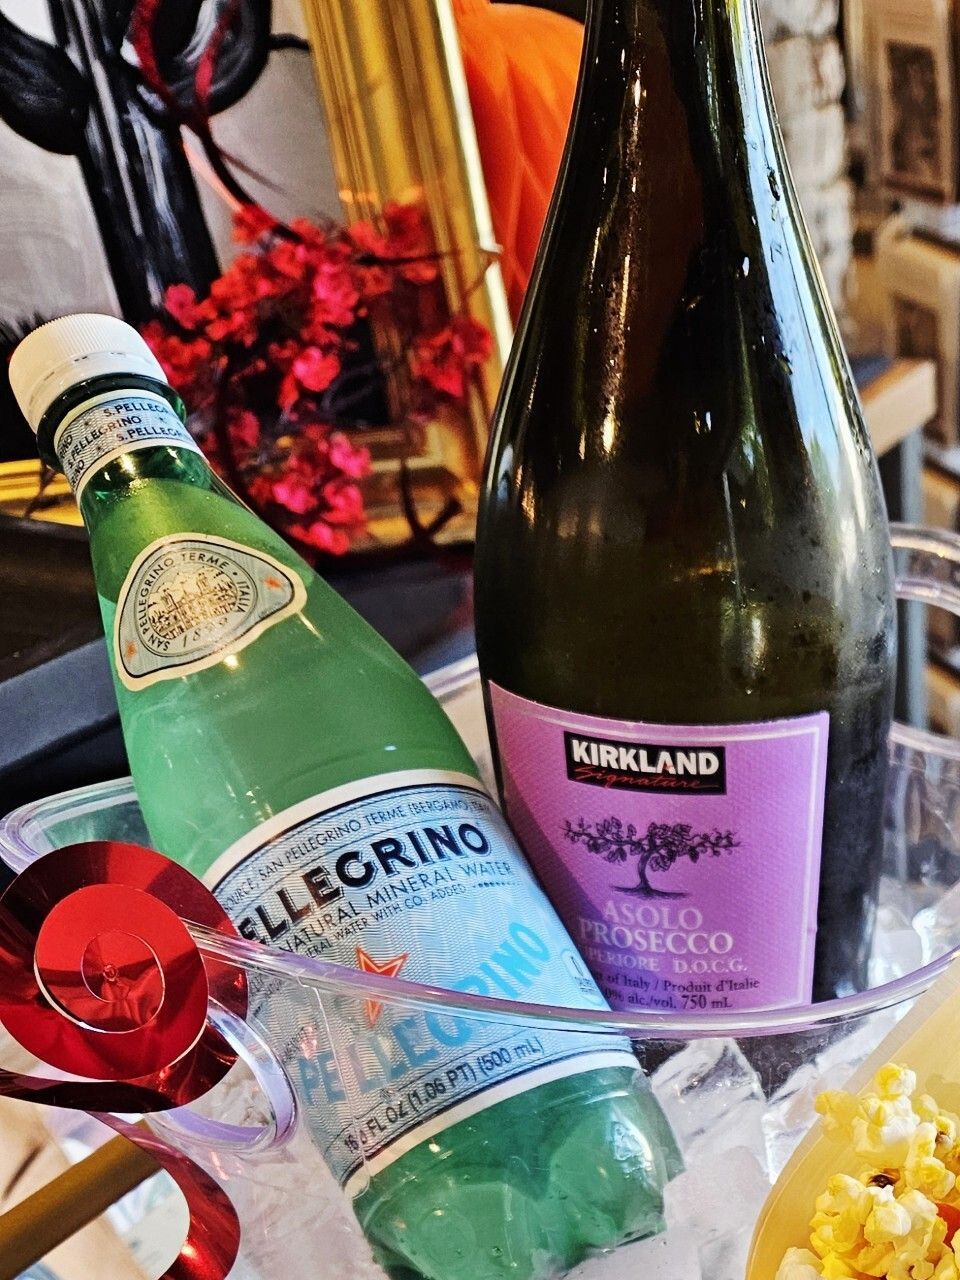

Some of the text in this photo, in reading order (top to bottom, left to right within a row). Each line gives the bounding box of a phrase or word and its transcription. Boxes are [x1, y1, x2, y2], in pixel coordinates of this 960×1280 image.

[181, 552, 230, 570] TERME
[138, 557, 175, 636] PELLEGRINO
[236, 580, 251, 614] ITALIA
[150, 631, 171, 651] SAN
[571, 739, 720, 775] KIRKLAND
[573, 765, 720, 790] Signature
[259, 856, 284, 881] SAN
[285, 819, 362, 863] PELLEGRINO
[364, 803, 405, 827] TERME
[237, 823, 491, 946] ELLEGRINO
[366, 867, 457, 908] MINERAL
[459, 861, 513, 878] WATER
[306, 938, 333, 959] ERAL
[334, 917, 371, 941] WATER
[371, 903, 404, 922] WITH
[431, 882, 467, 900] ADDED
[603, 900, 703, 932] ASOLO
[579, 918, 734, 955] PROSECCO
[673, 957, 748, 974] D.O.C.G.
[623, 975, 651, 992] Italy
[663, 980, 713, 994] Produit
[681, 994, 707, 1011] 750
[711, 996, 734, 1010] mL
[366, 1117, 387, 1137] FL
[408, 1079, 447, 1112] (1.06
[446, 1062, 477, 1088] PT)
[477, 1047, 512, 1077] (500
[515, 1036, 545, 1059] mL)
